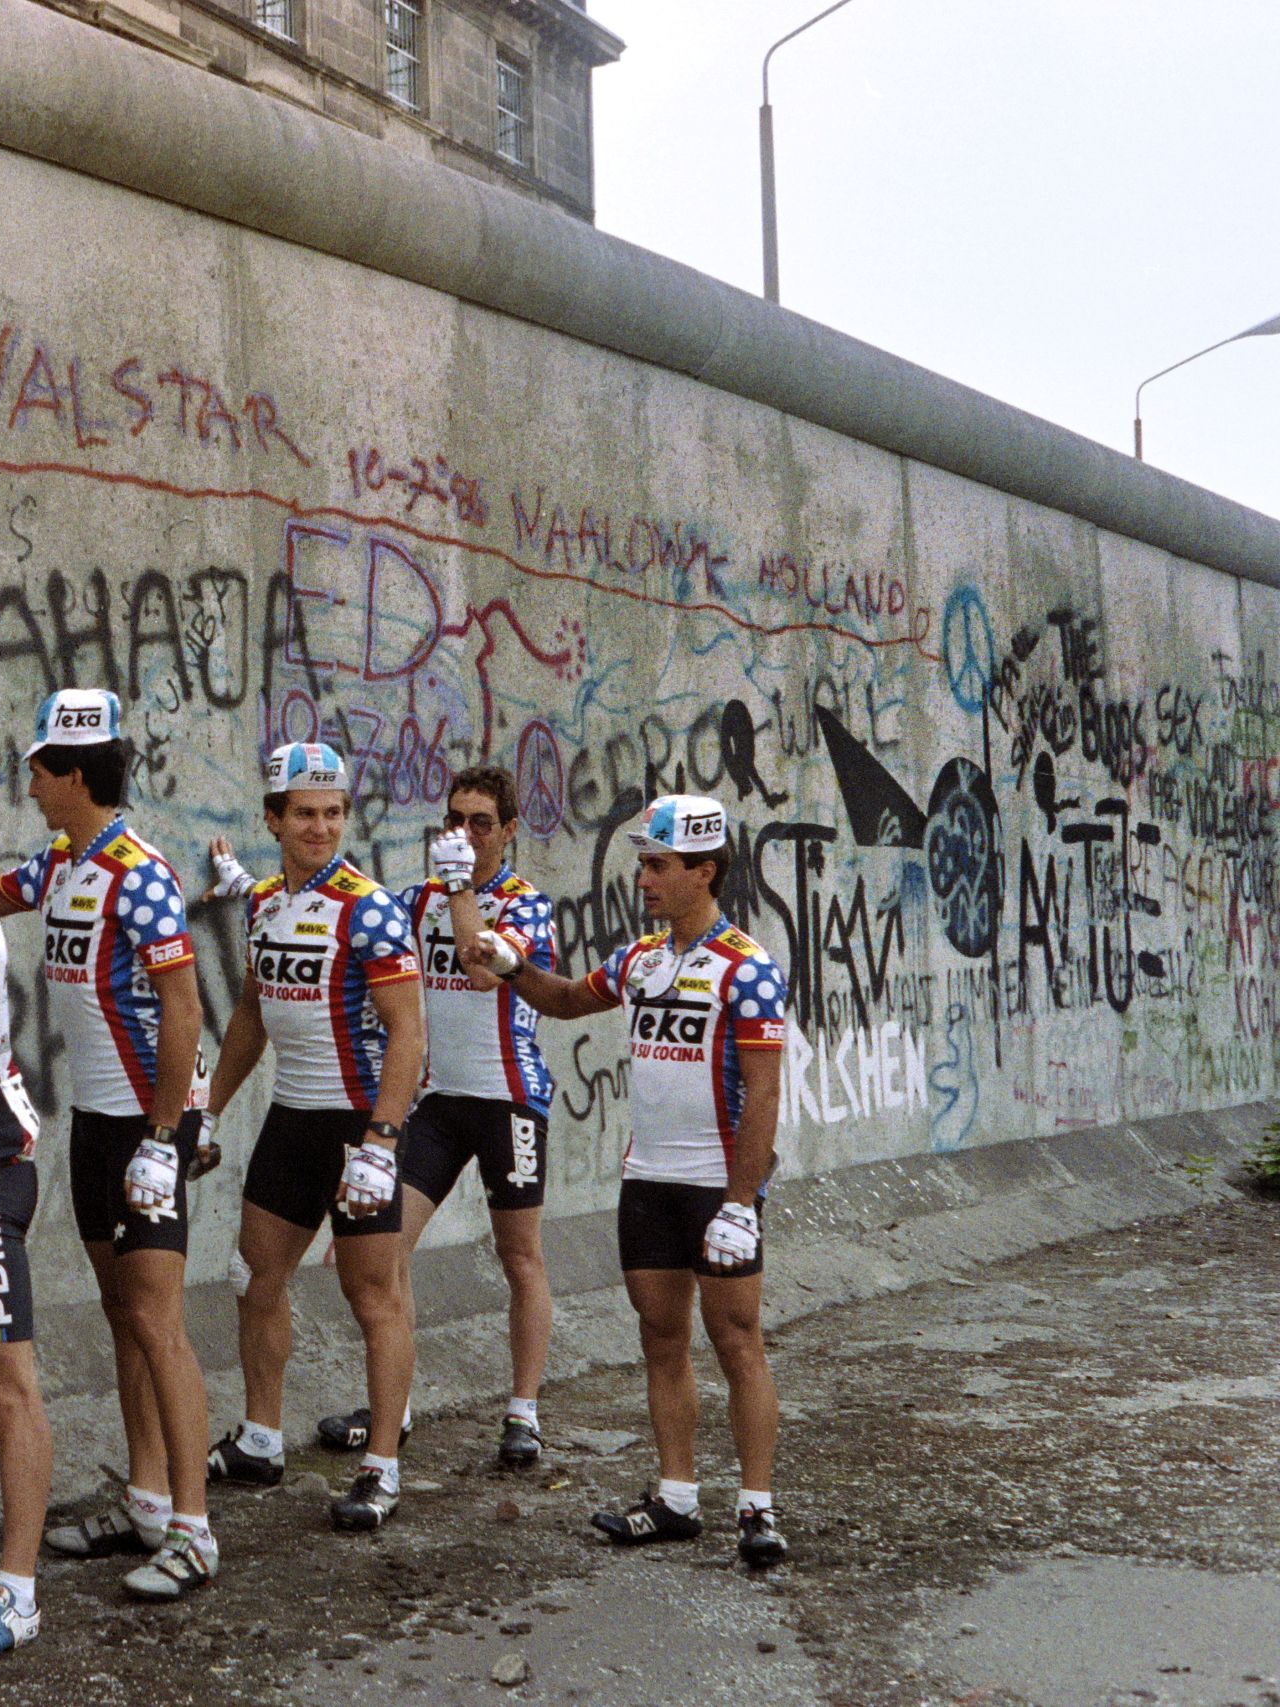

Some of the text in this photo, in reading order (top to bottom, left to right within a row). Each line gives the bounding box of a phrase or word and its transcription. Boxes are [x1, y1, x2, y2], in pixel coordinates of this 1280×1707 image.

[294, 923, 328, 936] MAVIC
[55, 966, 90, 985] COCINA
[435, 978, 449, 991] SU
[679, 978, 713, 992] MAVIC
[276, 987, 323, 1002] COCINA
[653, 1046, 705, 1063] COCINA
